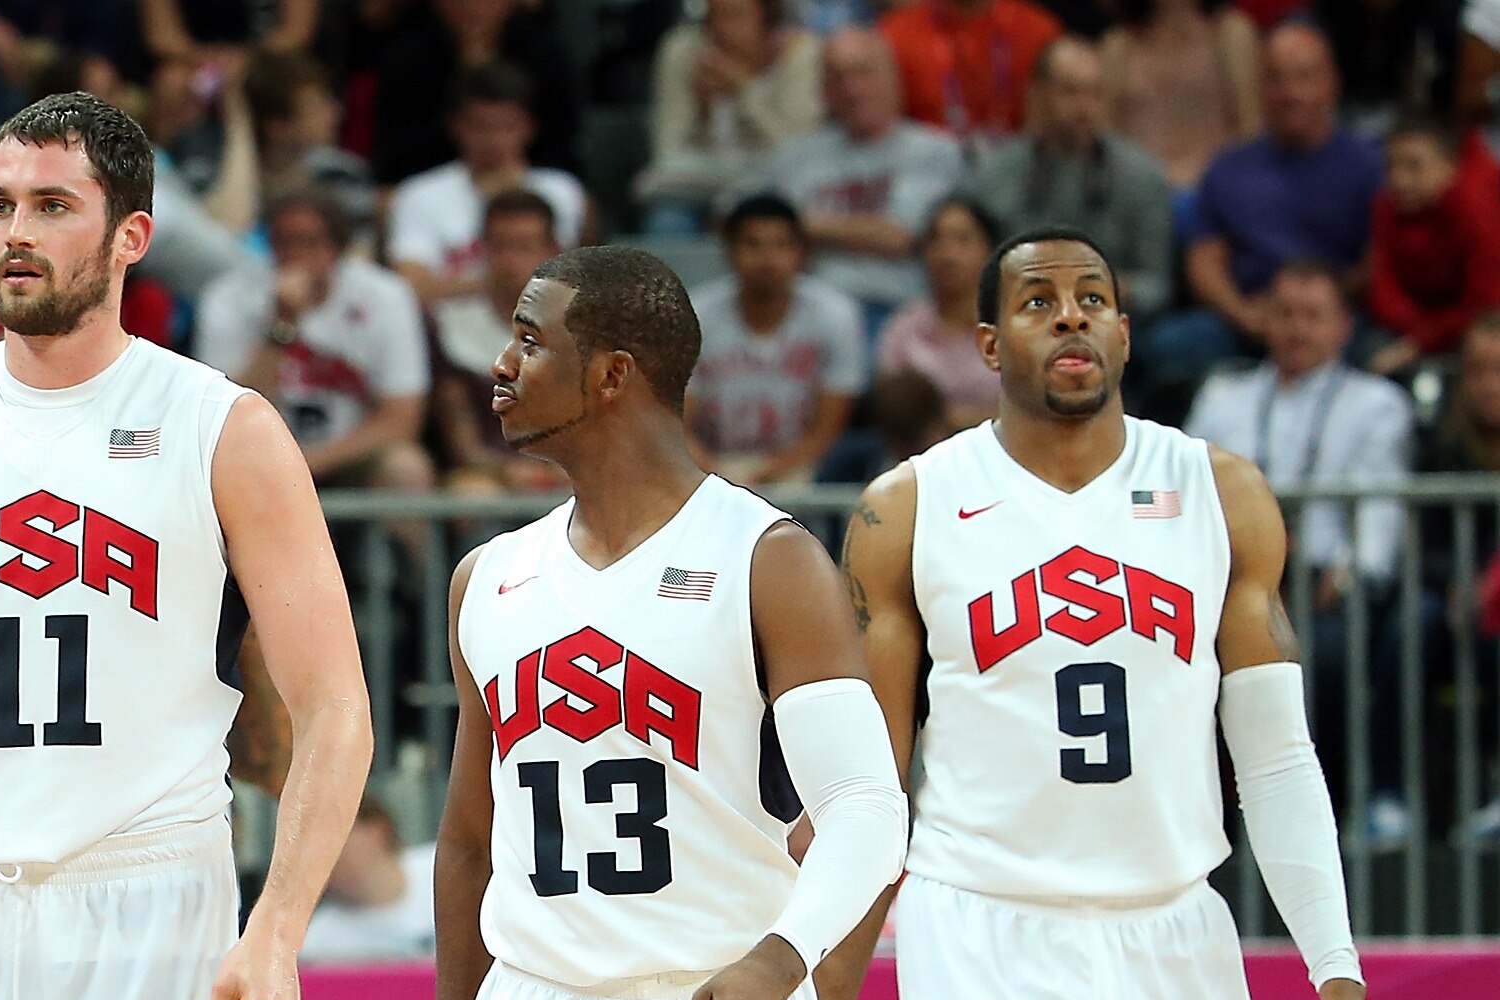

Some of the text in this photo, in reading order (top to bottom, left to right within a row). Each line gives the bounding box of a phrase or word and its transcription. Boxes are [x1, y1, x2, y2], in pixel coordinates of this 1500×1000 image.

[967, 545, 1196, 674] USA
[483, 624, 703, 773] USA
[1054, 661, 1134, 786] 9
[517, 757, 673, 898] 13
